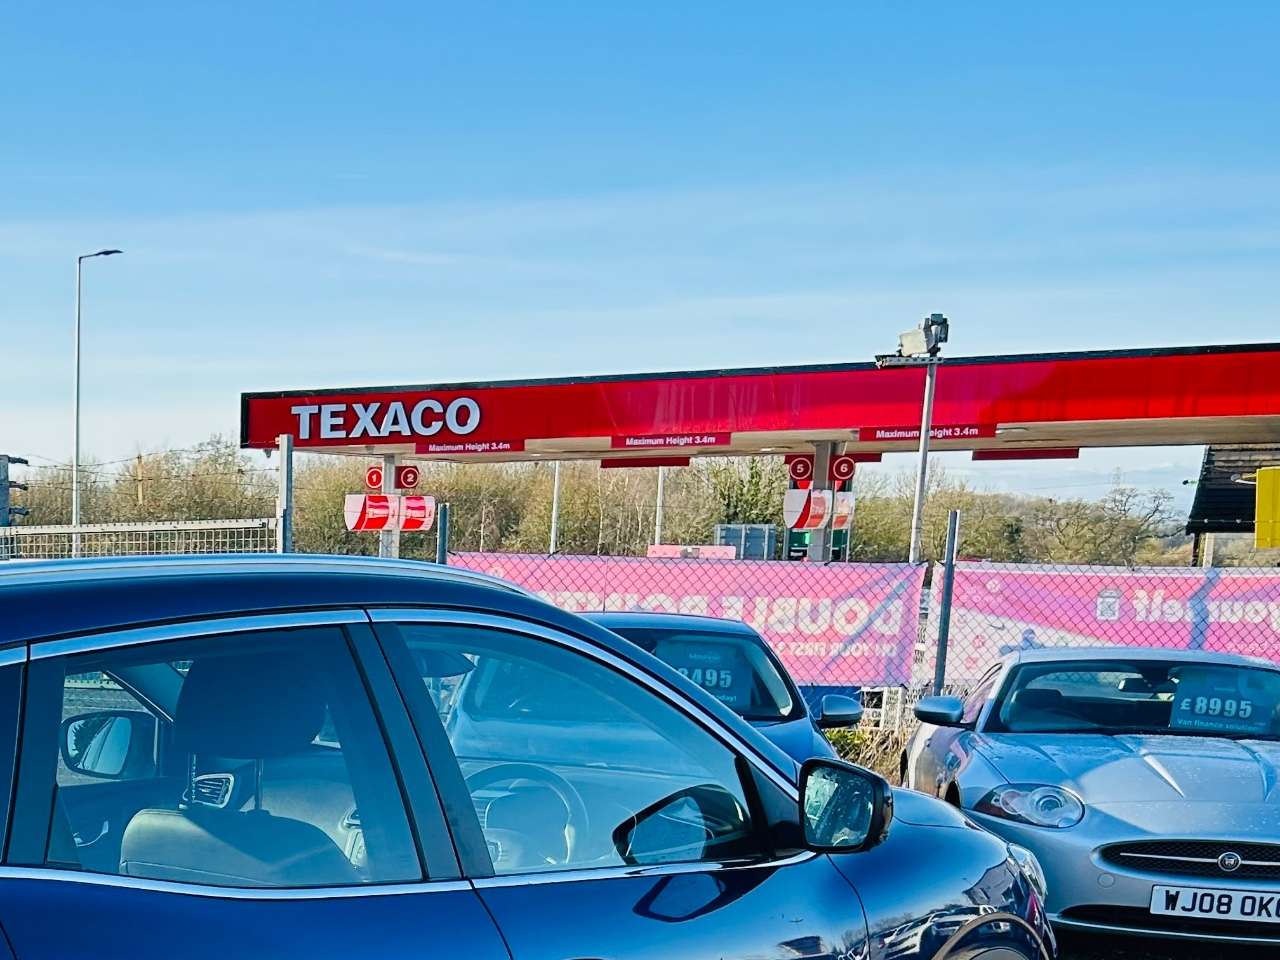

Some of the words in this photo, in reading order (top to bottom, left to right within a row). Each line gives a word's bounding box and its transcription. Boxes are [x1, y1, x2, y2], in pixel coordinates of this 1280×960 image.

[291, 397, 482, 440] TEXACO
[876, 429, 919, 439] Maximum
[929, 429, 952, 438] eight
[953, 427, 979, 437] 3.4m
[626, 437, 664, 446] Maximum
[666, 436, 693, 446] Height
[694, 436, 715, 444] 3.4m
[428, 443, 464, 452] Maximum
[465, 442, 490, 452] Height
[491, 442, 511, 450] 3.4m
[796, 463, 804, 473] 5
[839, 463, 848, 473] 6
[1165, 889, 1233, 915] WJ08
